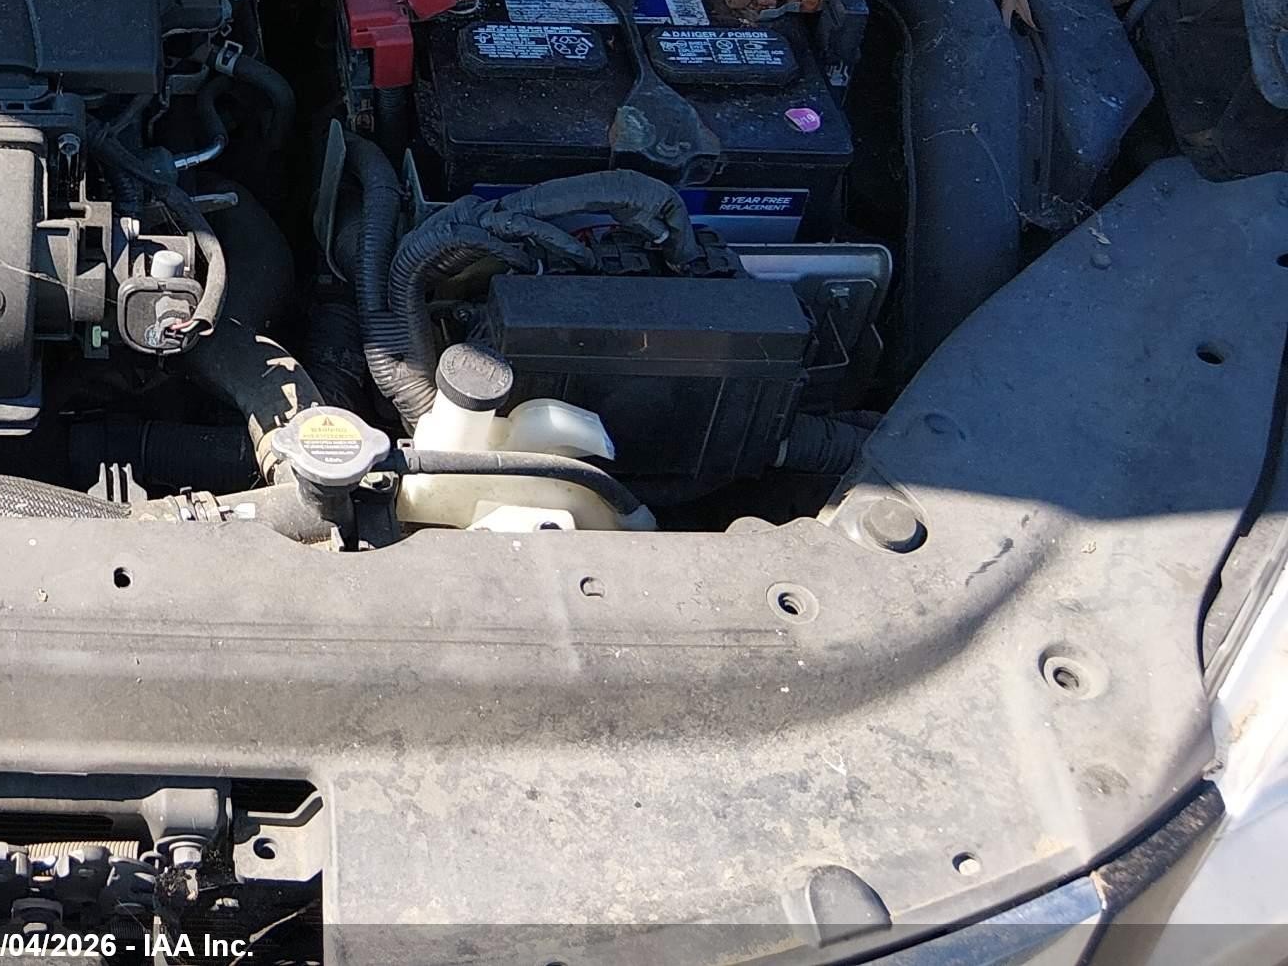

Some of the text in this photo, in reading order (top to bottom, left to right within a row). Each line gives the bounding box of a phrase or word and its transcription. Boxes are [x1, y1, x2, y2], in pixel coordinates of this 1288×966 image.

[721, 196, 793, 205] 3 YEAR FREE
